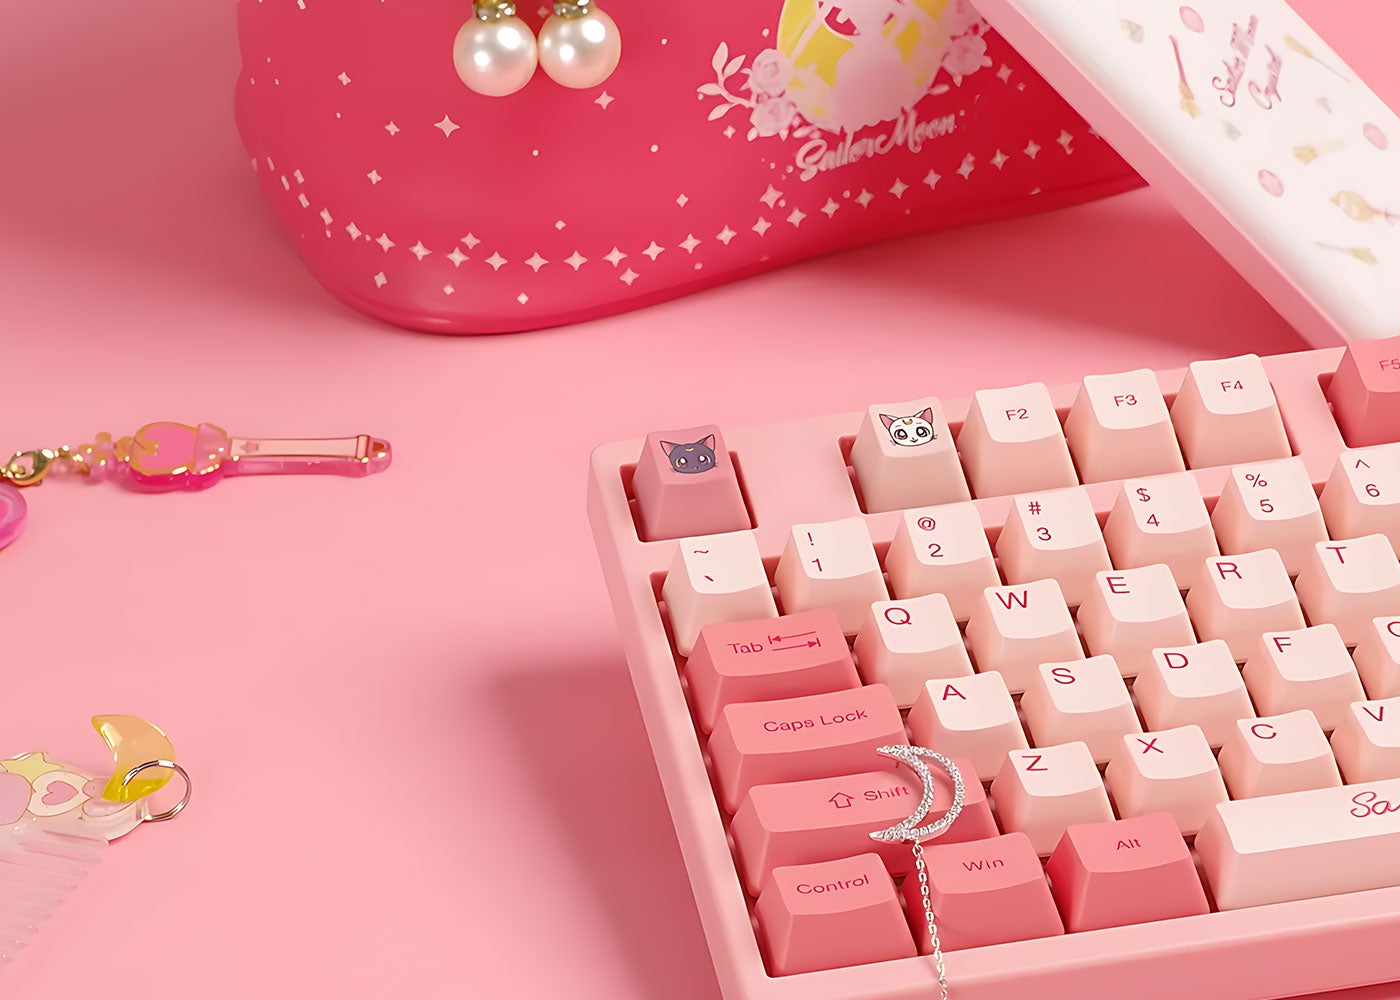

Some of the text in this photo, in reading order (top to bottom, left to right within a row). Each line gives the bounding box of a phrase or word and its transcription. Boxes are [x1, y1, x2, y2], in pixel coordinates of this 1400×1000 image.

[1220, 380, 1244, 393] F4
[1113, 394, 1138, 407] F3
[1005, 408, 1029, 421] F2
[1245, 473, 1268, 488] %
[1136, 487, 1151, 503] $
[1365, 483, 1381, 498] 6
[1027, 500, 1042, 516] #
[1259, 498, 1274, 514] 5
[917, 516, 936, 532] @
[1146, 513, 1160, 527] 4
[1036, 526, 1052, 542] 3
[927, 543, 944, 558] 2
[1325, 546, 1348, 565] T
[811, 558, 823, 572] 1
[1215, 562, 1243, 581] R
[1105, 576, 1131, 594] E
[994, 590, 1030, 610] W
[883, 607, 913, 626] Q
[727, 642, 764, 654] Tab
[1272, 636, 1292, 653] F
[1163, 652, 1189, 669] D
[1051, 667, 1076, 685] S
[942, 683, 967, 701] A
[763, 709, 869, 733] Caps Lock
[1362, 705, 1385, 722] V
[1250, 723, 1277, 740] C
[1136, 737, 1165, 755] X
[1024, 754, 1049, 772] Z
[863, 786, 910, 802] Shift
[1116, 838, 1142, 851] Alt
[961, 859, 1005, 872] Win
[796, 874, 870, 895] Control
